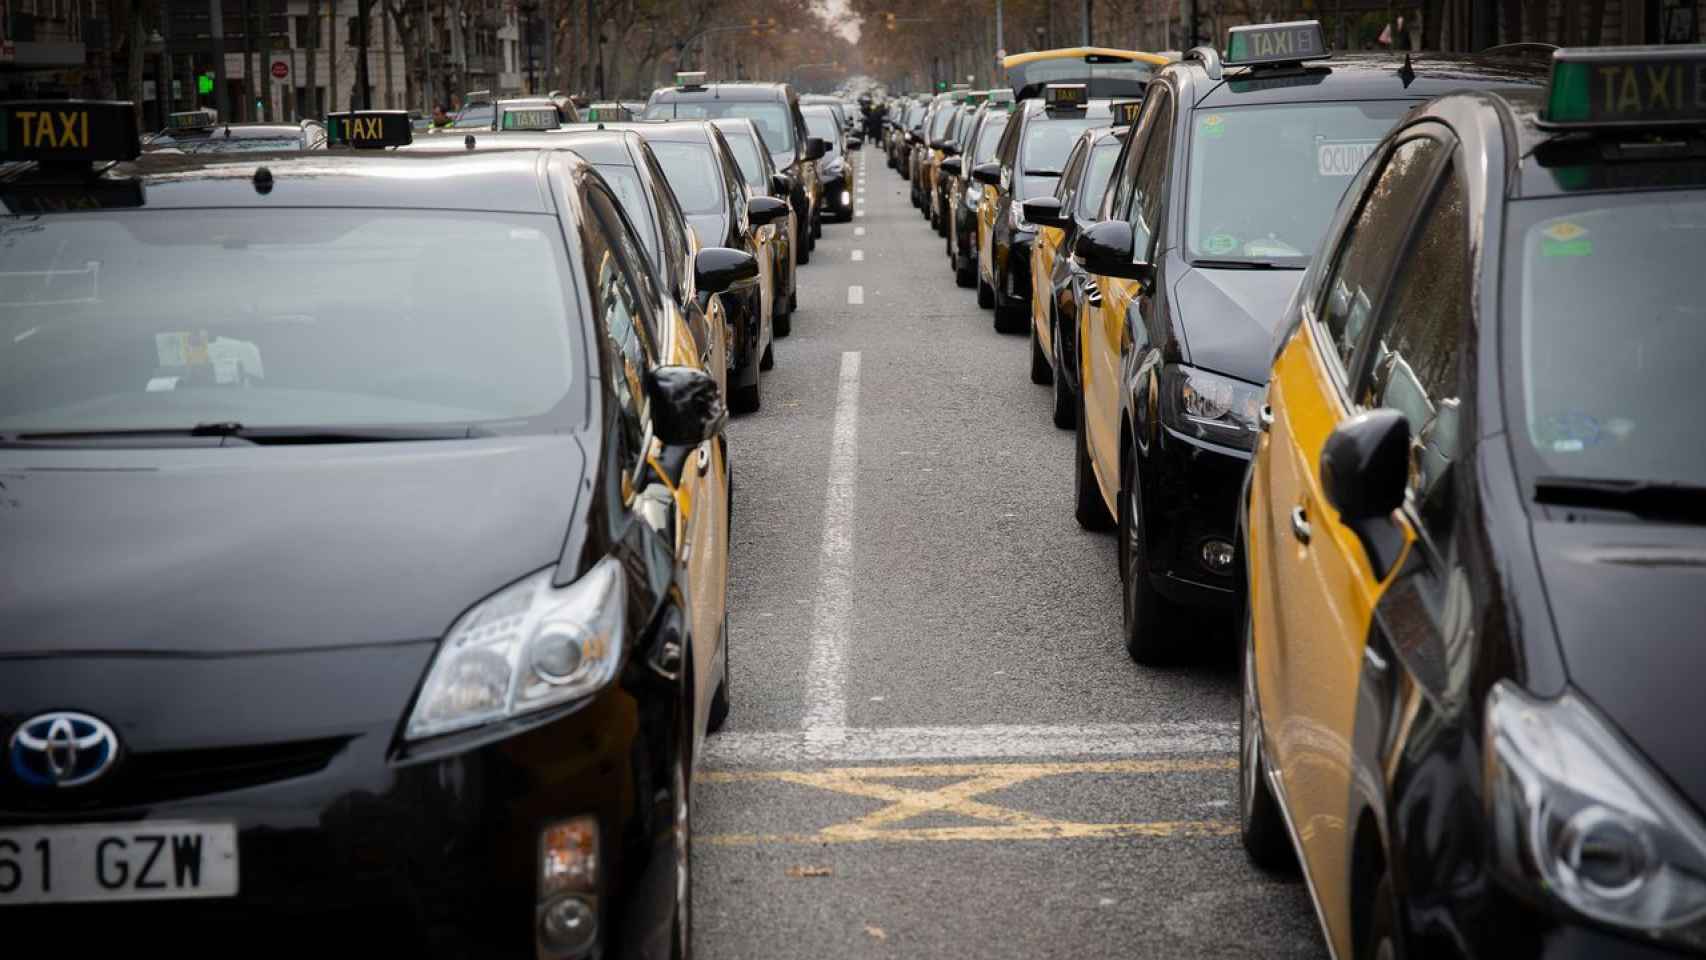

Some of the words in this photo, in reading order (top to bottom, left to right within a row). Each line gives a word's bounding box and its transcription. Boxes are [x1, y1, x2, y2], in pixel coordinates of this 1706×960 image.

[1251, 31, 1293, 57] TAXI
[1599, 64, 1683, 112] TAXI
[16, 111, 88, 148] TAXI
[341, 117, 384, 139] TAXI
[1322, 146, 1373, 173] OCUPA
[95, 834, 203, 890] GZW
